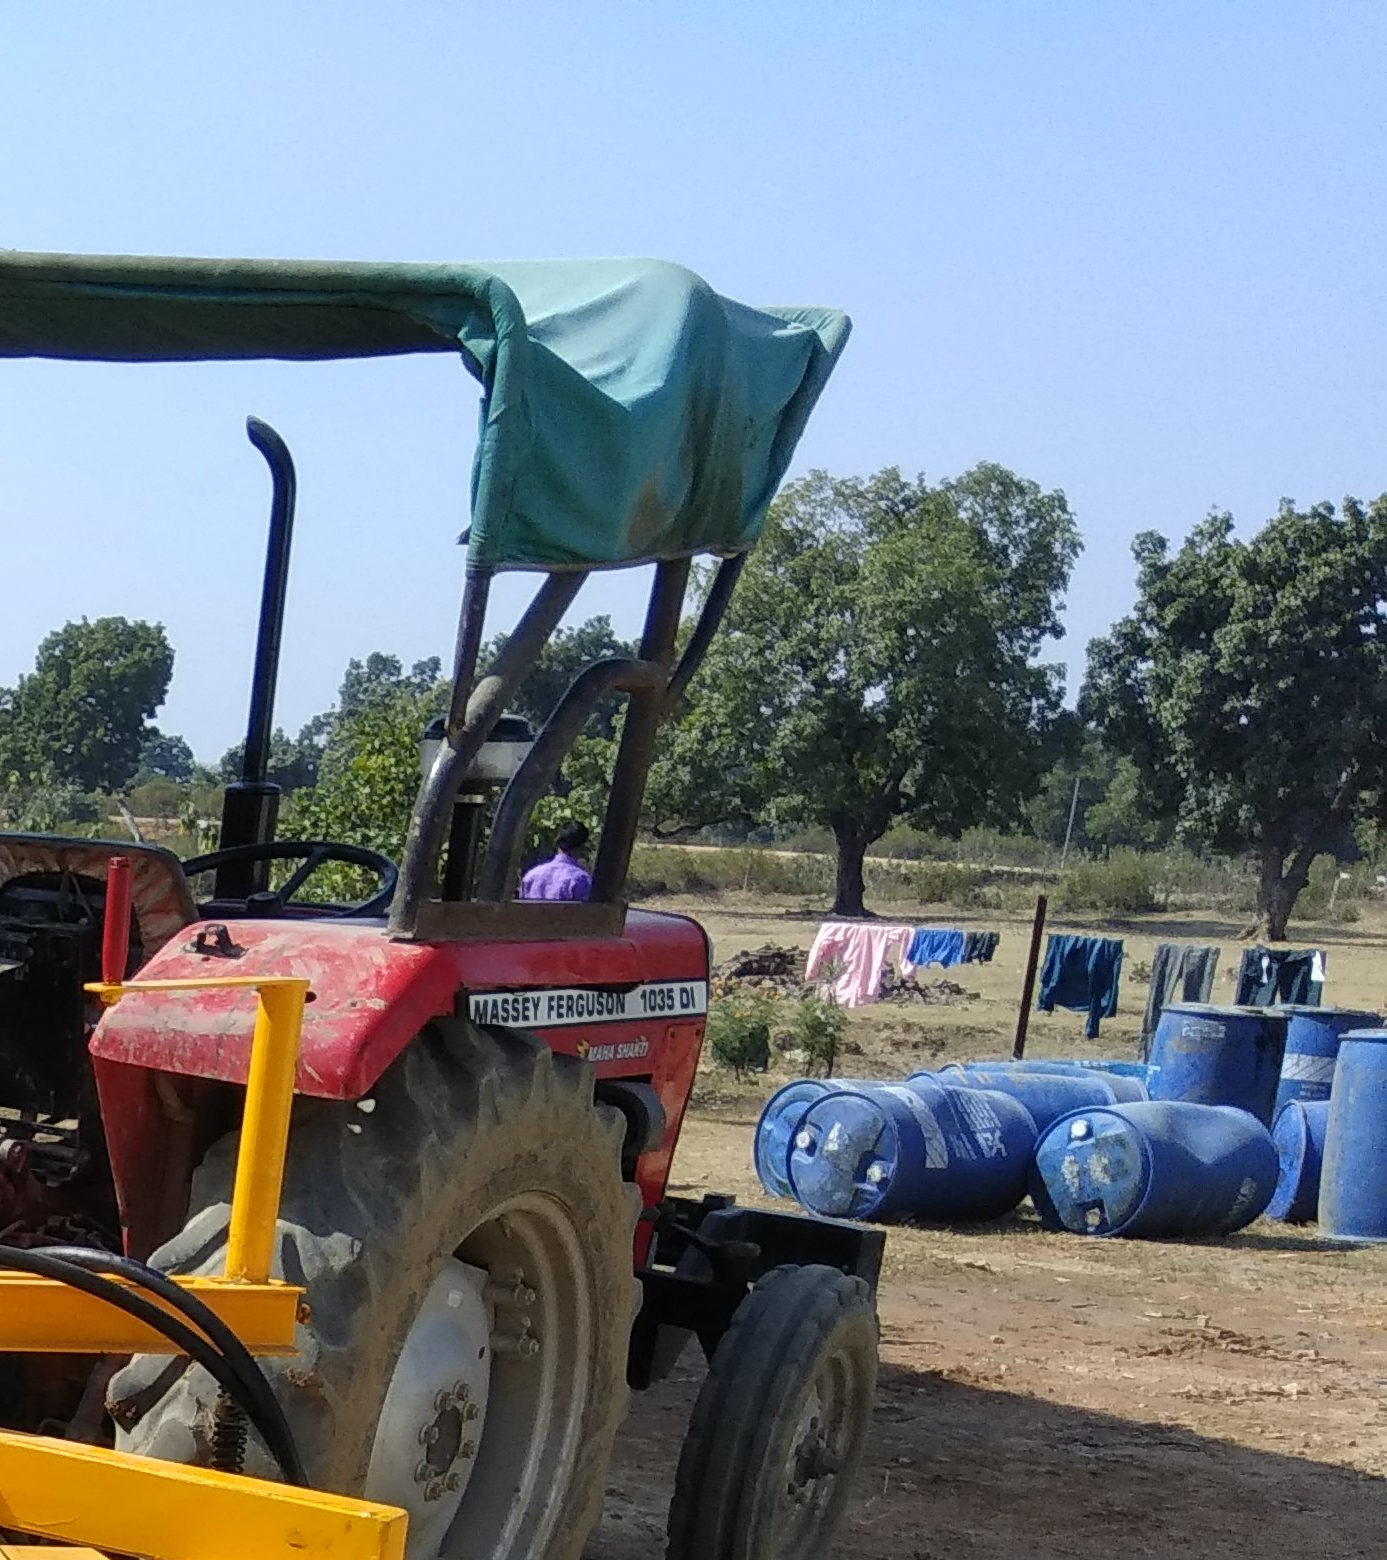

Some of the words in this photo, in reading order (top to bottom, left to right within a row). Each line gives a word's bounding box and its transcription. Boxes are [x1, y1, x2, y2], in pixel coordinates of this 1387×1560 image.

[474, 995, 541, 1025] MASSEY
[547, 992, 625, 1019] FERGUSON
[640, 988, 675, 1013] 1035
[679, 986, 696, 1009] DI
[588, 1045, 615, 1062] MAHA
